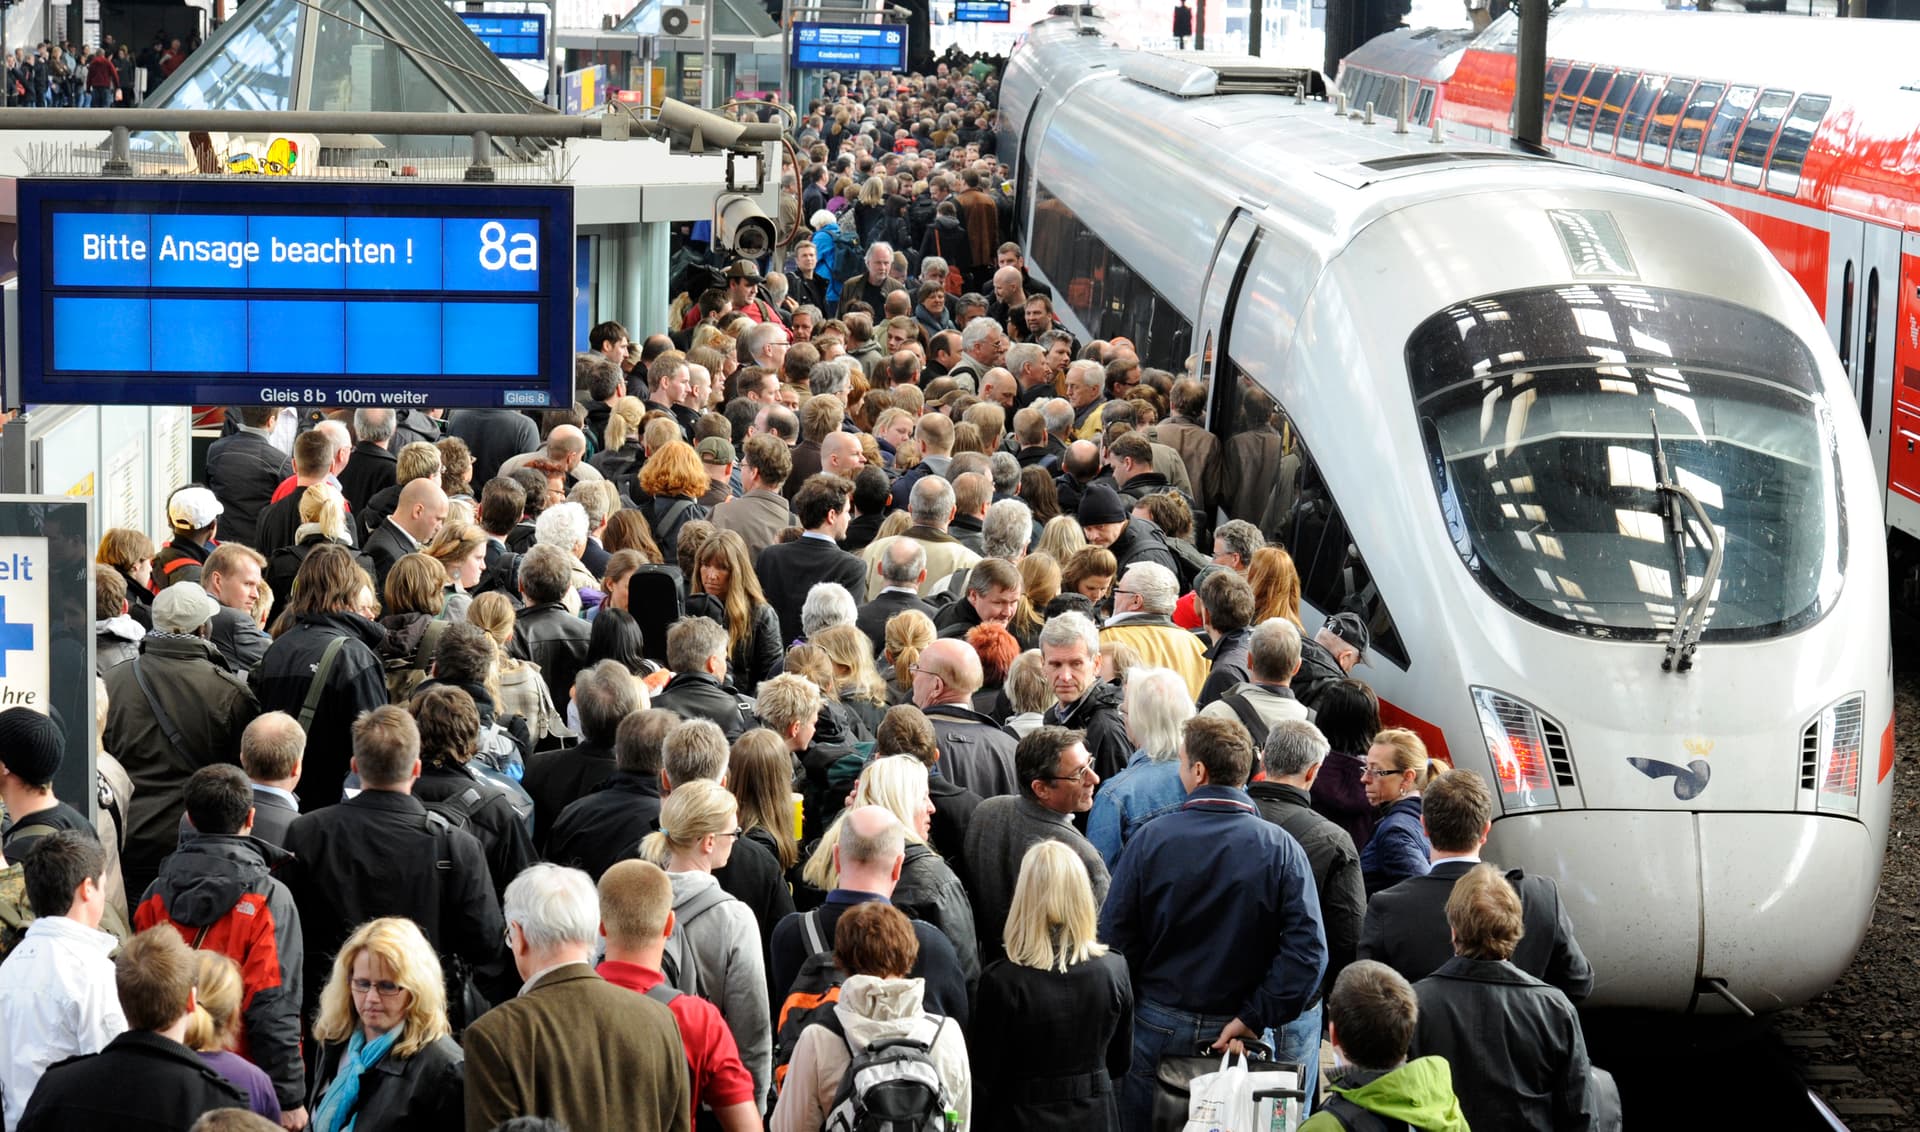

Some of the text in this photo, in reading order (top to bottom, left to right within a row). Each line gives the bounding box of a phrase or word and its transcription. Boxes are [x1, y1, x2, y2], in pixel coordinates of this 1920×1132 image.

[885, 31, 901, 44] 8b
[83, 233, 413, 269] Bitte Ansage beachten !
[478, 221, 538, 271] 8a
[260, 388, 300, 402] Gleis
[335, 389, 376, 403] 100m
[380, 390, 429, 404] weiter
[506, 392, 545, 404] Gleis 8
[2, 686, 36, 705] hre
